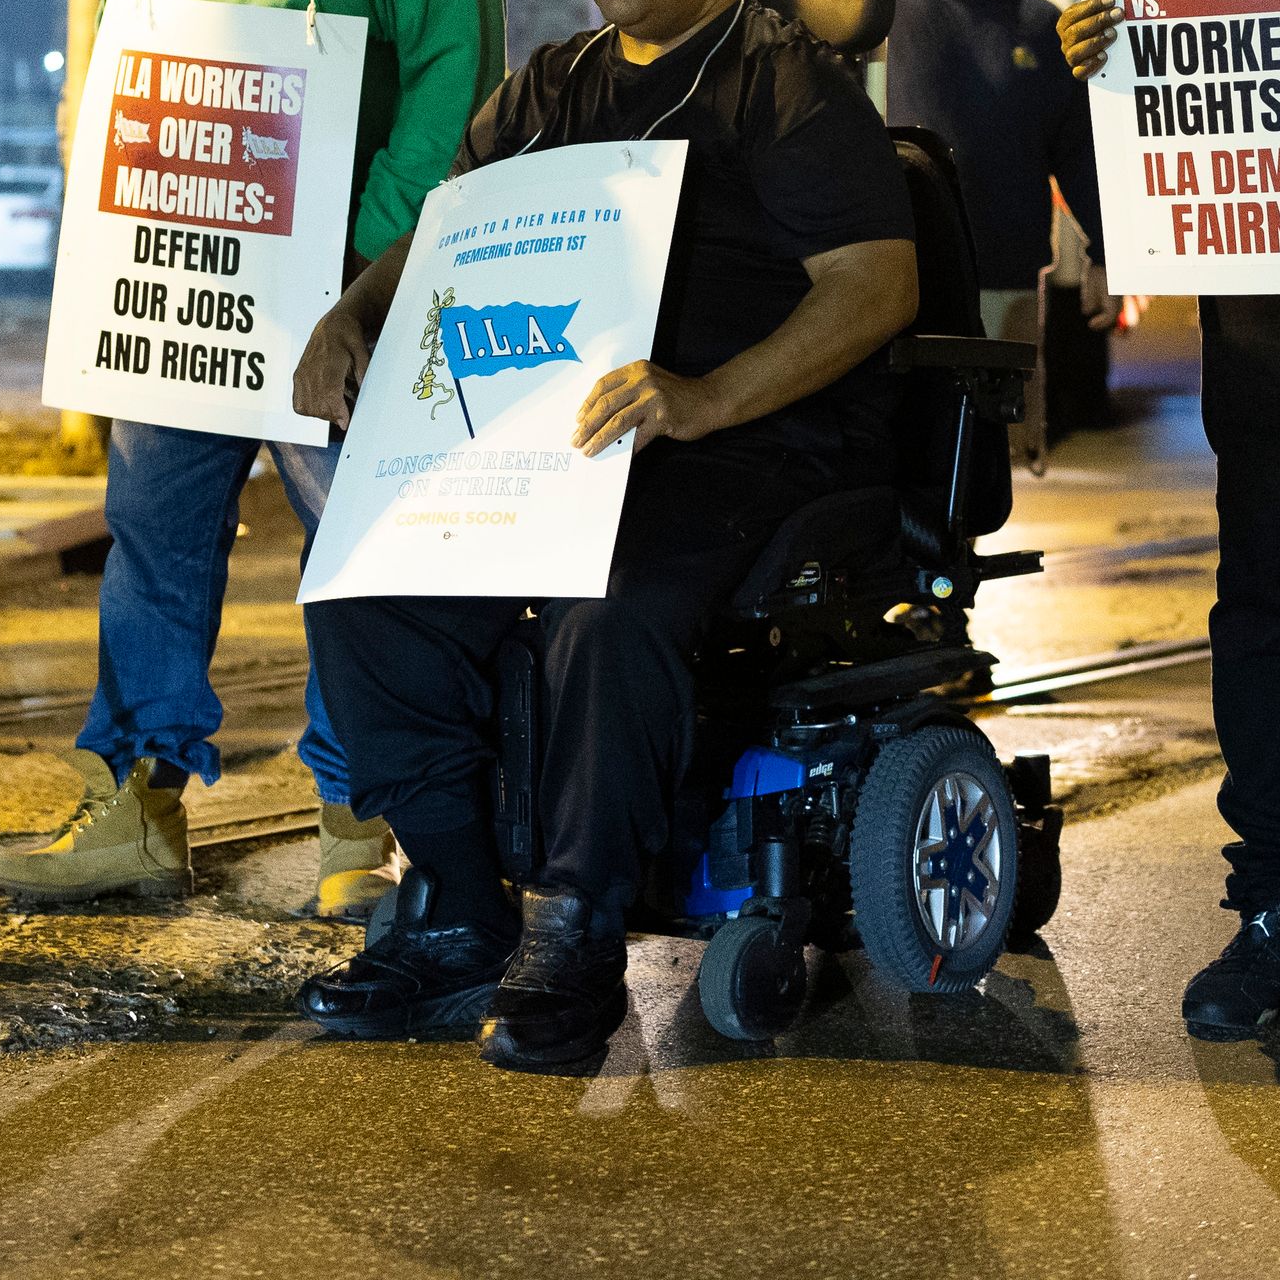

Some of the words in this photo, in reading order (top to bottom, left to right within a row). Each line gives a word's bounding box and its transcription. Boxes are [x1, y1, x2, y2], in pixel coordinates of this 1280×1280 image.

[115, 55, 151, 101] ILA
[160, 62, 304, 117] WORKERS
[158, 116, 233, 166] OVER
[114, 166, 274, 224] MACHINES:
[1143, 152, 1199, 197] ILA
[133, 225, 241, 276] DEFEND
[439, 226, 477, 250] COMING
[483, 221, 496, 235] TO
[502, 218, 509, 231] A
[515, 213, 544, 229] PIER
[551, 210, 586, 225] NEAR
[595, 209, 621, 222] YOU
[453, 241, 512, 268] PREMIERING
[514, 236, 564, 256] OCTOBER
[567, 235, 587, 251] 1ST
[113, 277, 167, 324] OUR
[176, 287, 255, 335] JOBS
[455, 315, 566, 361] I.L.A.
[95, 330, 150, 375] AND
[160, 342, 266, 392] RIGHTS
[375, 451, 572, 478] LONGSHOREMEN
[398, 479, 430, 499] ON
[439, 477, 531, 497] STRIKE
[396, 512, 460, 526] COMING
[465, 511, 517, 525] SOON
[809, 762, 834, 777] edge
